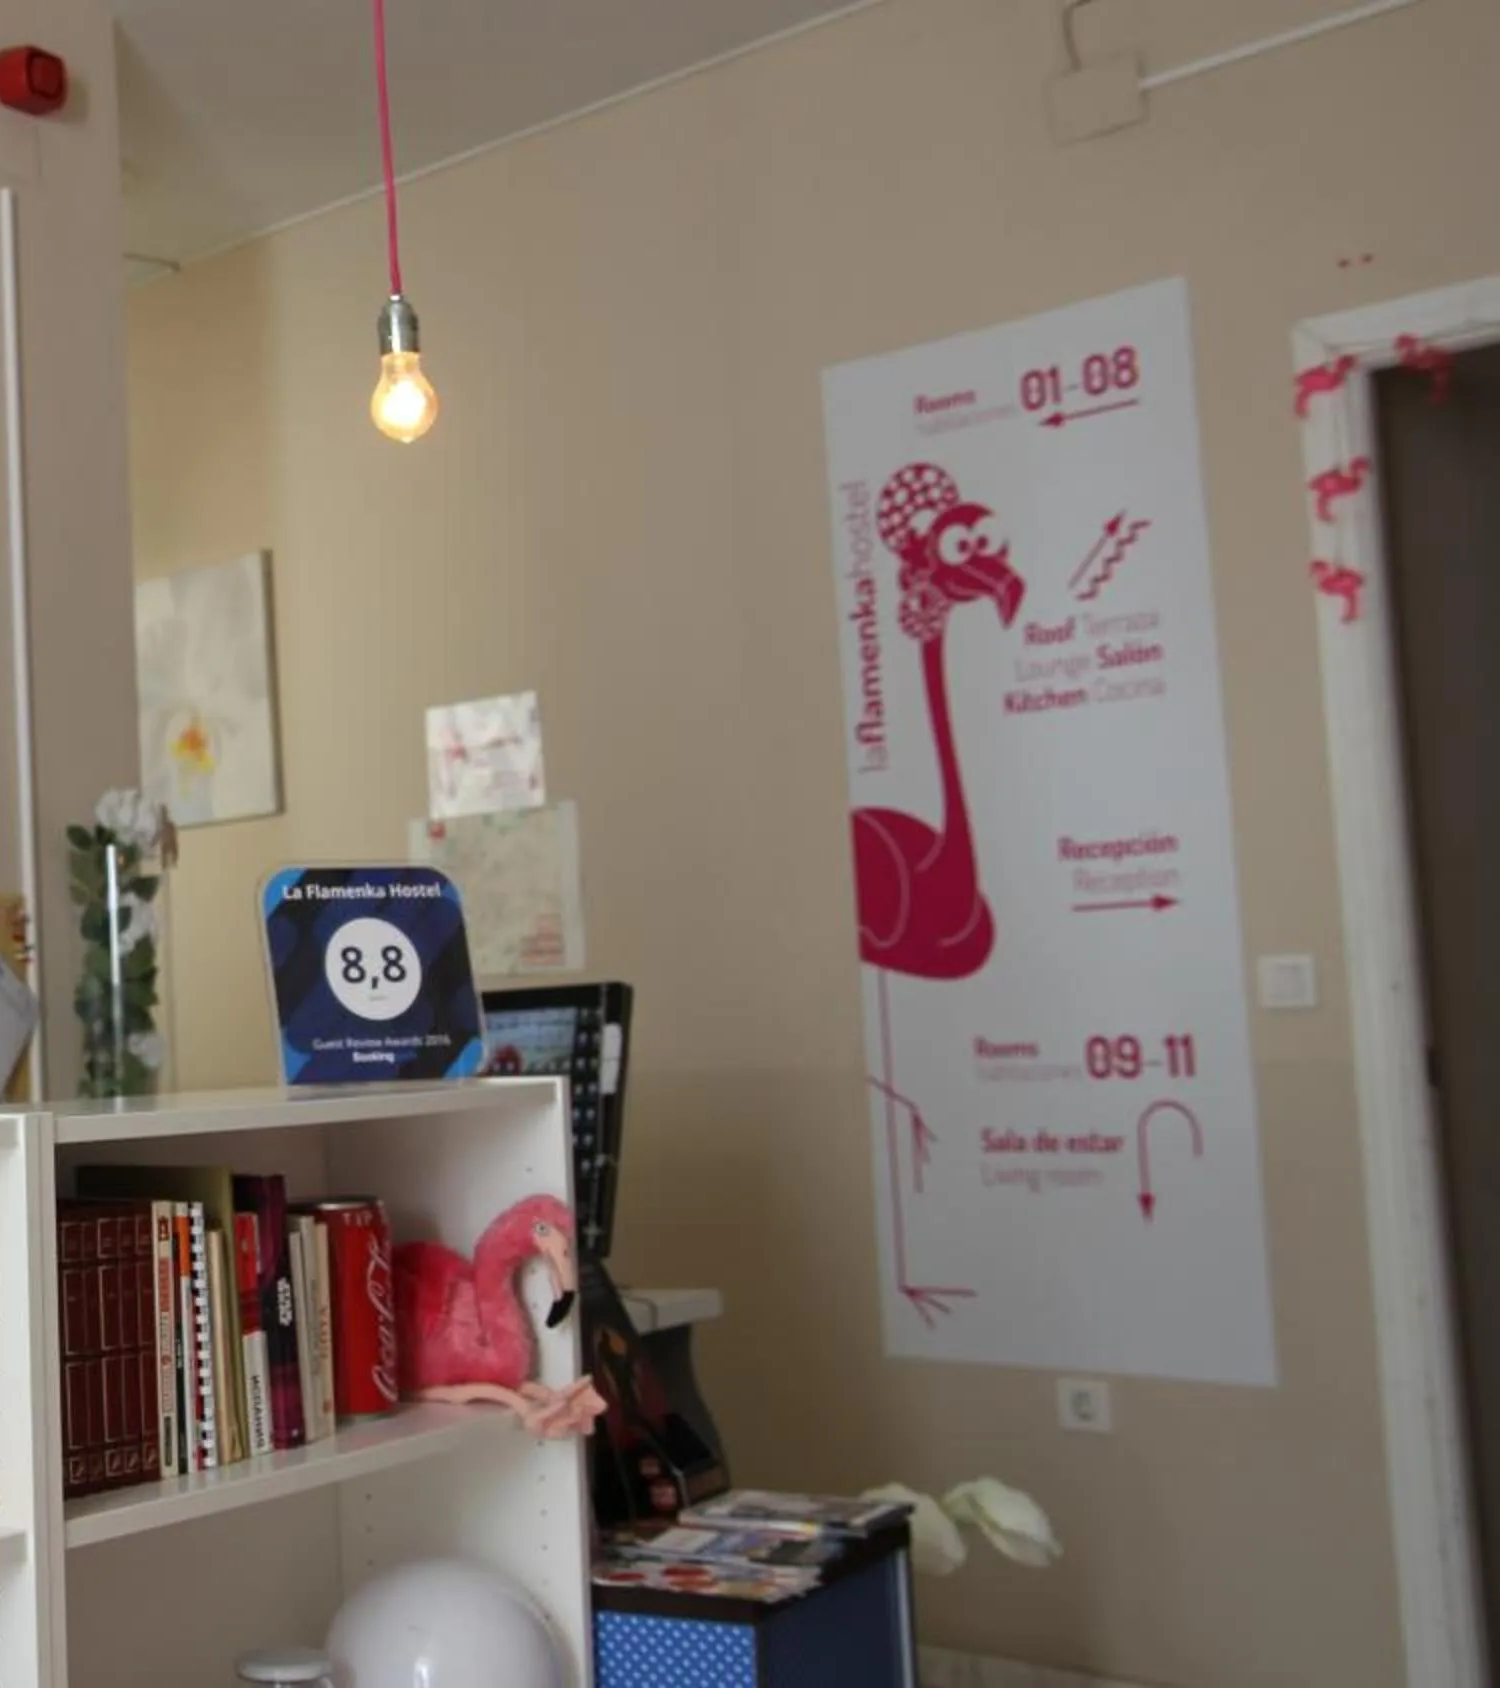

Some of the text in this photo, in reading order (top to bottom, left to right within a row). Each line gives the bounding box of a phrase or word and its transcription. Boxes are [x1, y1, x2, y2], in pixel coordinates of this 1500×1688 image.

[282, 881, 442, 900] La Flamenka Hostel
[340, 945, 407, 990] 8,8
